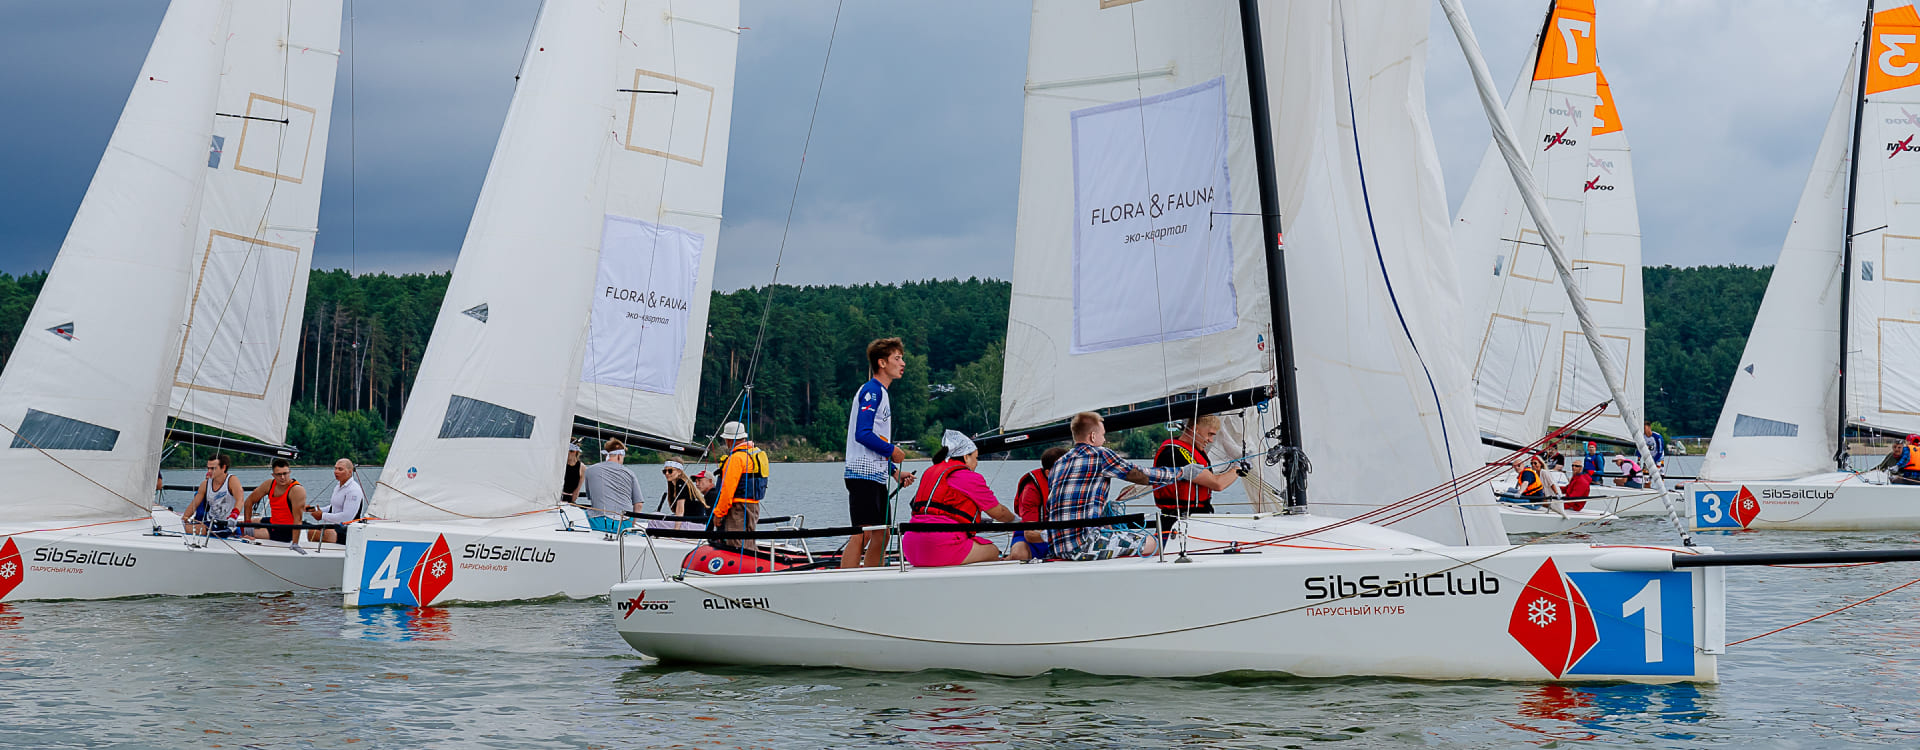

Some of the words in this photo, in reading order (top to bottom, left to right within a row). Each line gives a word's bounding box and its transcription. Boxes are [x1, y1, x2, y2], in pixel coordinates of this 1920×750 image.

[1543, 126, 1576, 151] MX700
[1886, 134, 1920, 159] MX70
[1091, 202, 1145, 225] FLORA
[1150, 193, 1164, 218] &
[1168, 186, 1214, 211] FAUNA
[1124, 224, 1188, 244] эко-квартал
[605, 286, 645, 304] FLORA
[647, 291, 656, 308] &
[659, 296, 687, 311] FAUNA
[1762, 489, 1834, 499] SibSailClub
[1702, 494, 1722, 524] 3
[33, 547, 137, 567] SibSailClub
[463, 543, 556, 563] SibSailClub
[368, 546, 402, 599] 4
[1304, 570, 1500, 600] SibSailClub
[617, 589, 669, 620] MX700
[703, 598, 770, 609] ALINGHI
[1306, 605, 1371, 617] ПАРУСНЫЙ
[1374, 605, 1405, 615] КЛУБ
[1622, 579, 1663, 663] 1
